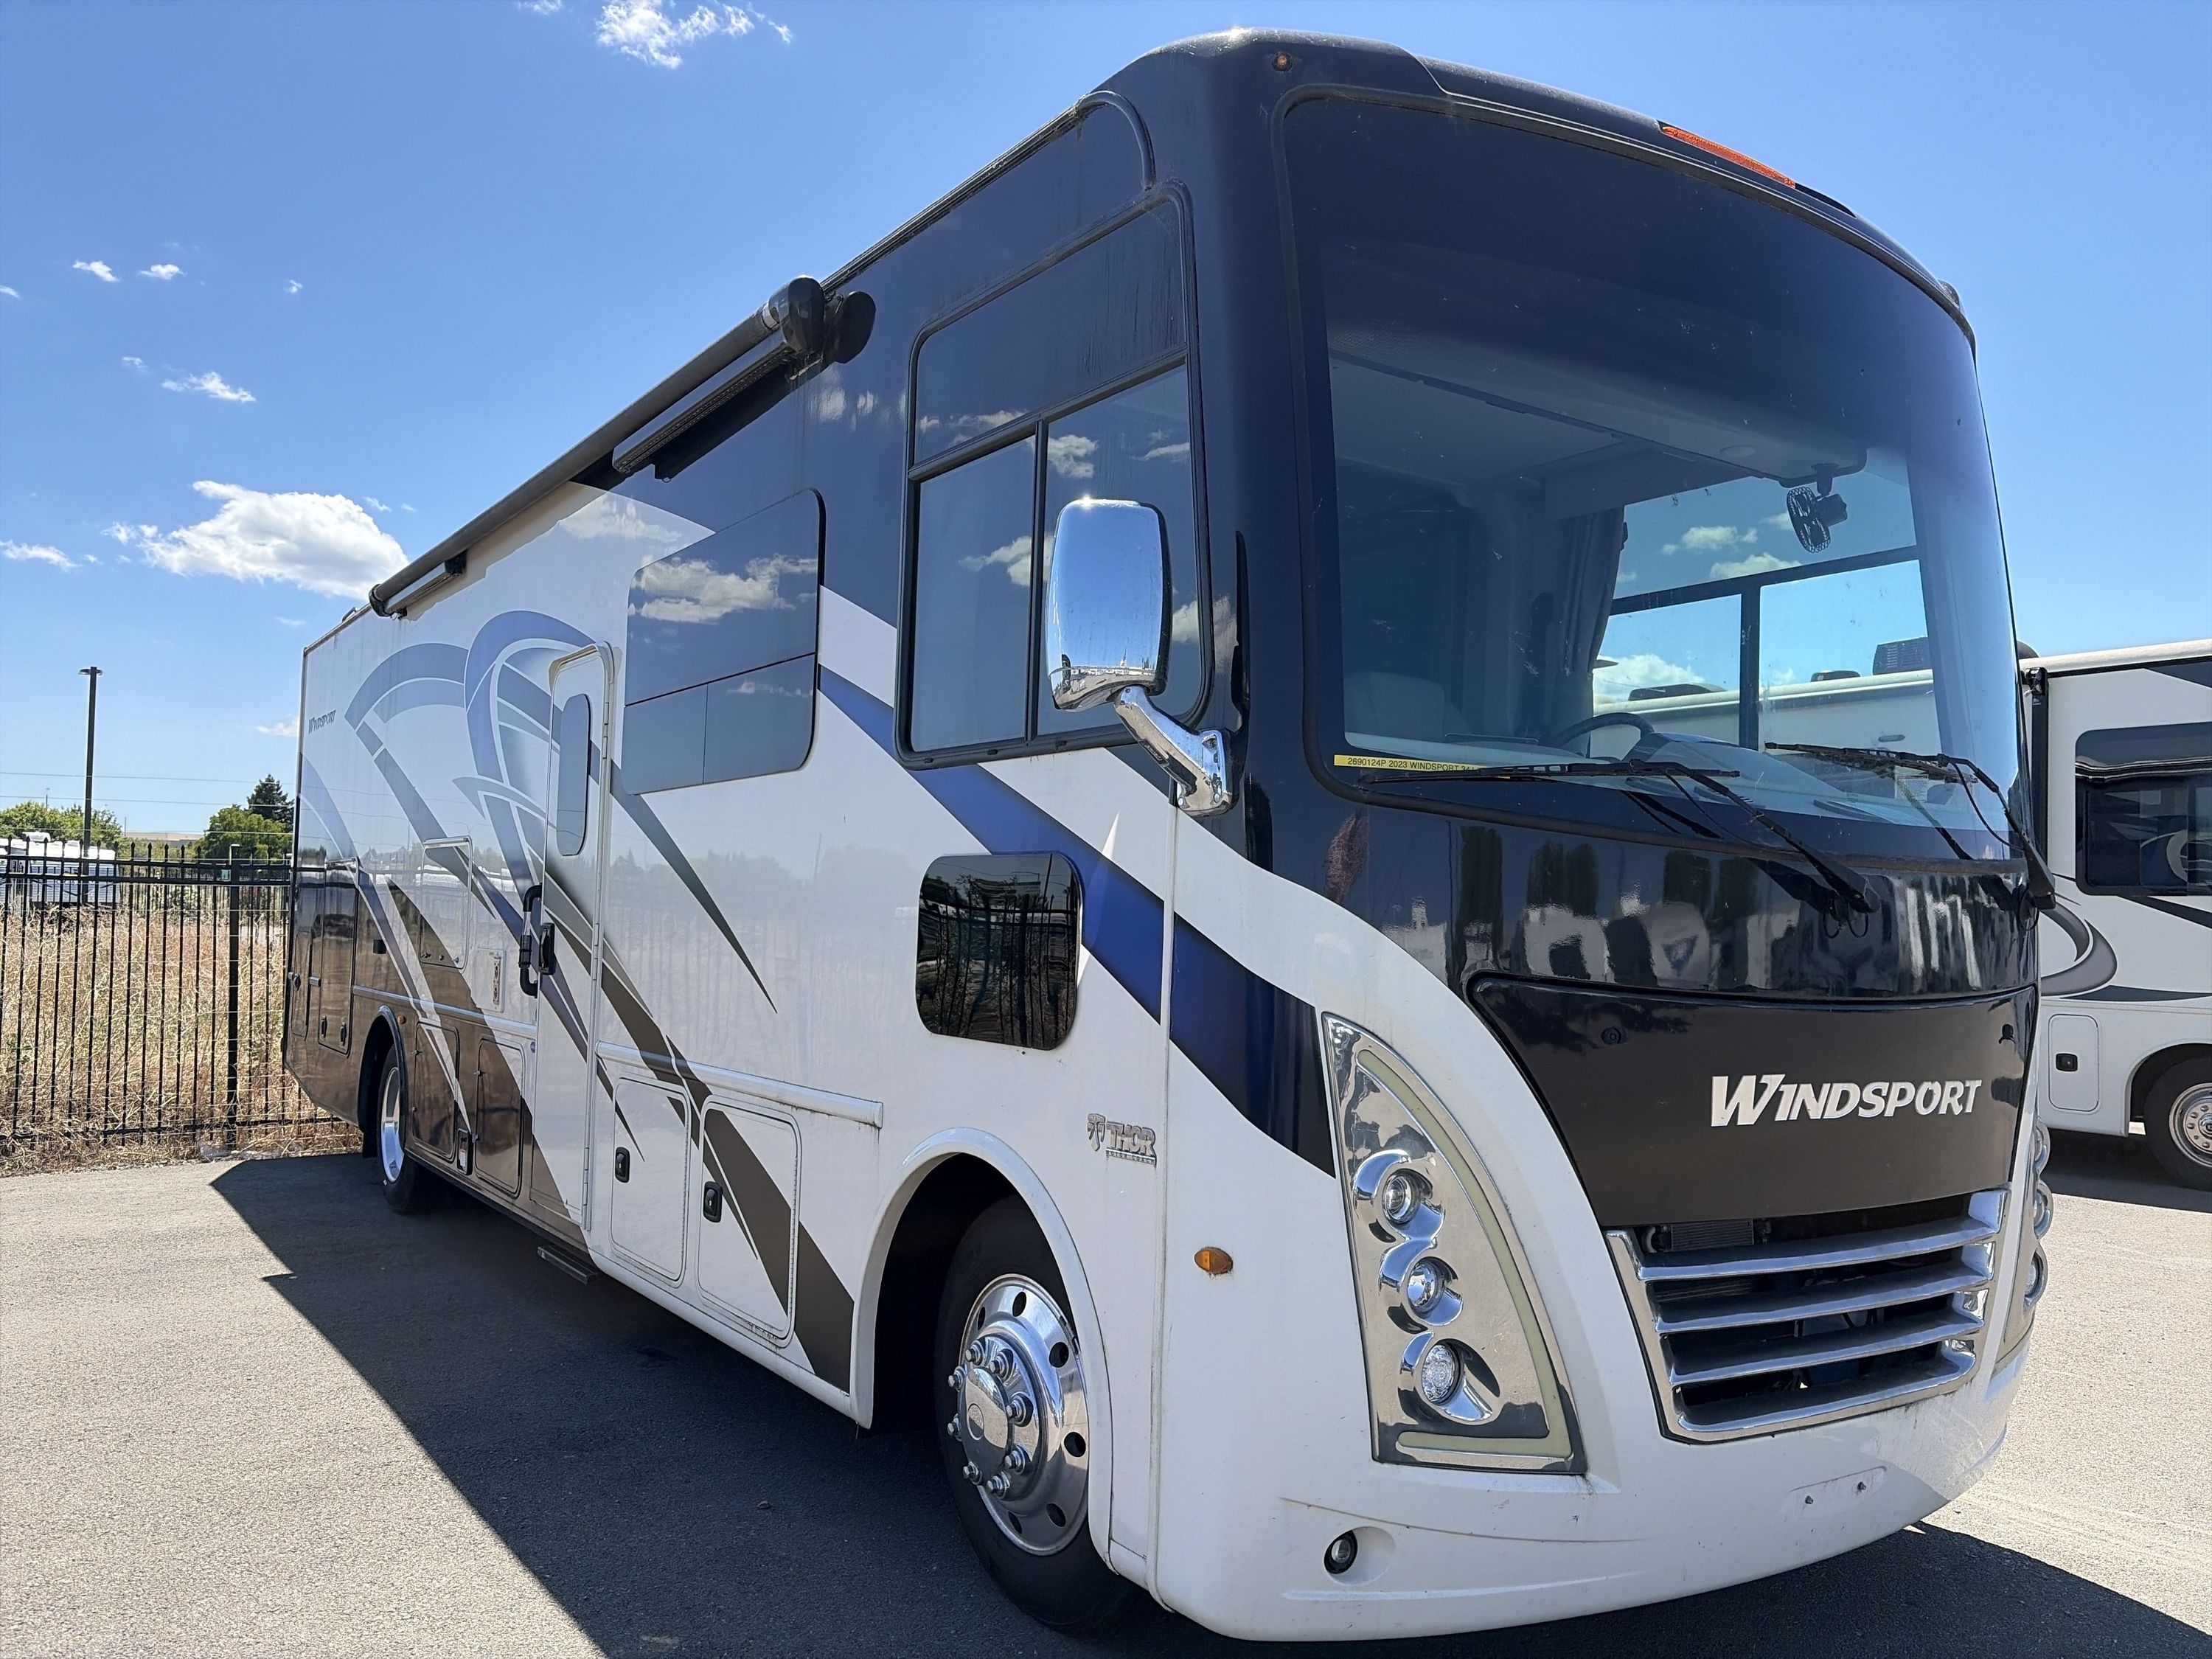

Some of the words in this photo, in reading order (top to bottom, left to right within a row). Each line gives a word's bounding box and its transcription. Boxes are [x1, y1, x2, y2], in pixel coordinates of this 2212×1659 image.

[1347, 757, 1386, 767] 2690124P
[1388, 760, 1408, 768] 2023
[1410, 762, 1459, 772] WINDSPORT
[1711, 1074, 1982, 1127] WINDSPORT
[1107, 1121, 1156, 1156] THOR
